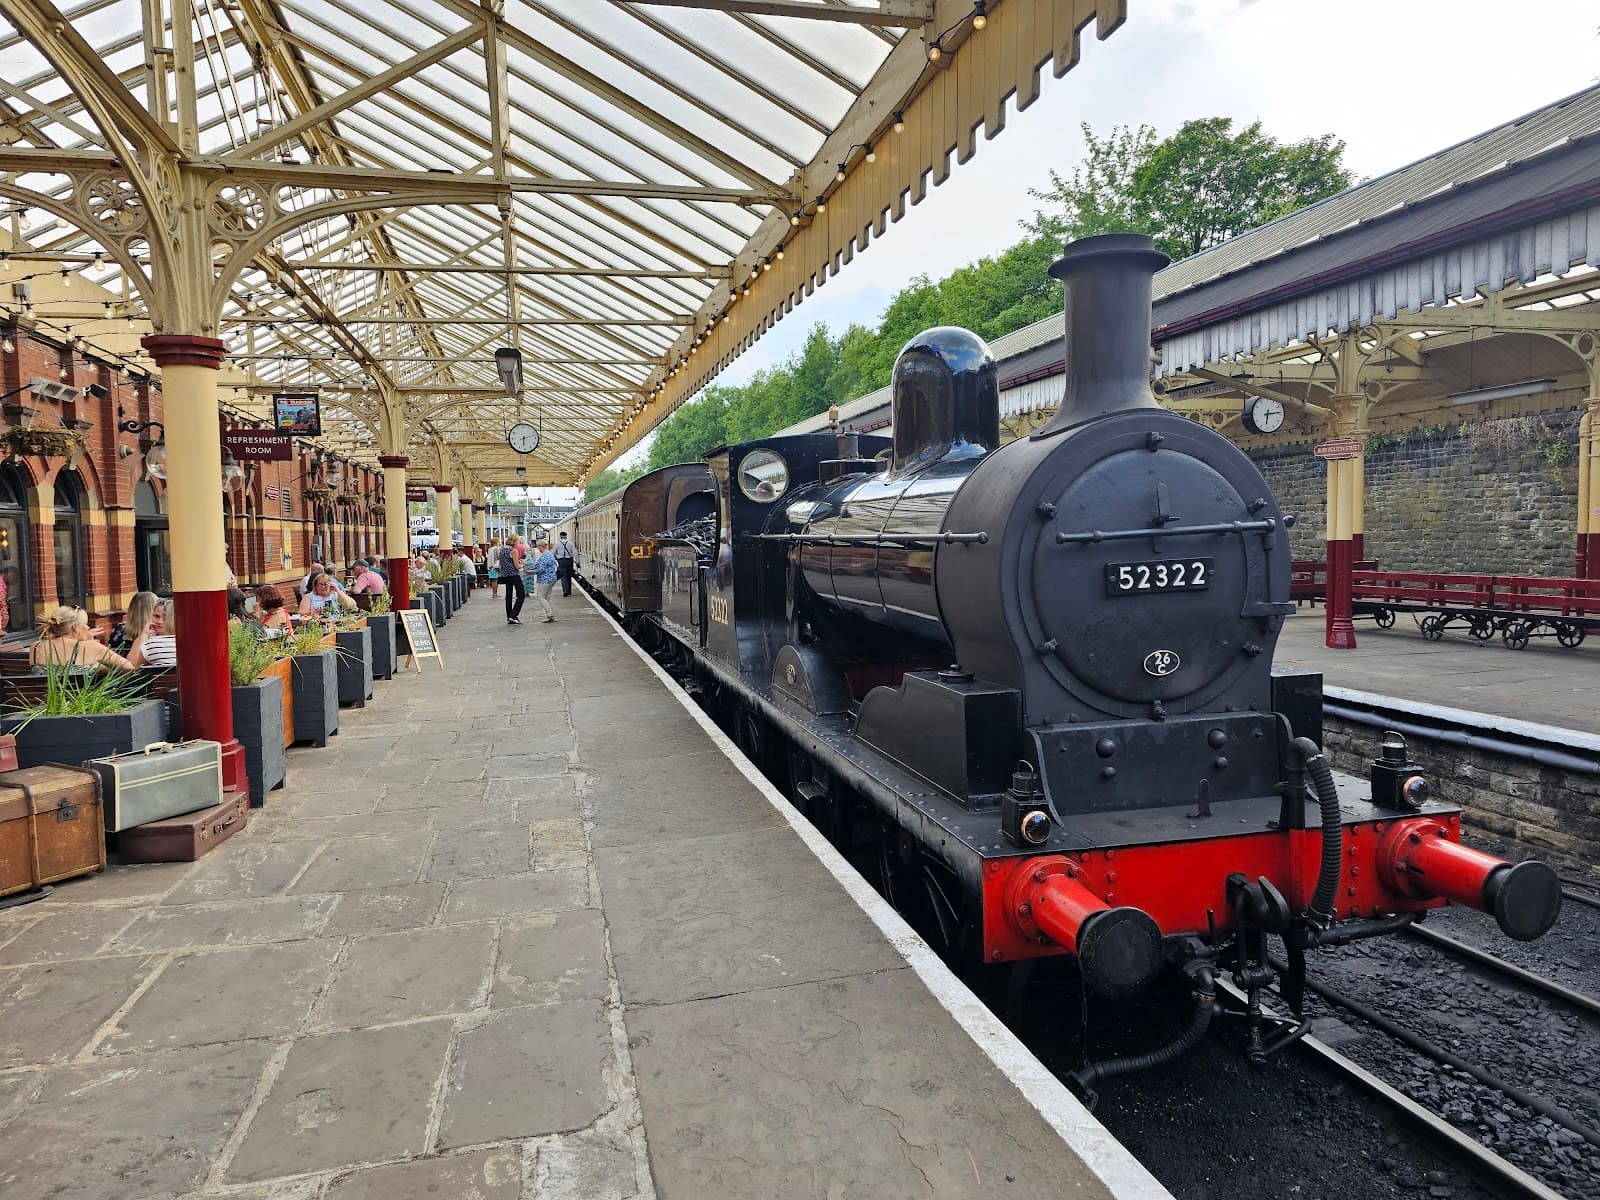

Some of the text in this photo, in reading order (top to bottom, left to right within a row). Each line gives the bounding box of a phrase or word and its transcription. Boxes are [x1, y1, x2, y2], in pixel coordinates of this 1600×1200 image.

[227, 436, 288, 444] REFRESHMENT
[1119, 562, 1205, 589] 52322
[711, 595, 728, 625] 52322
[1155, 652, 1170, 665] 26
[1157, 664, 1166, 673] C
